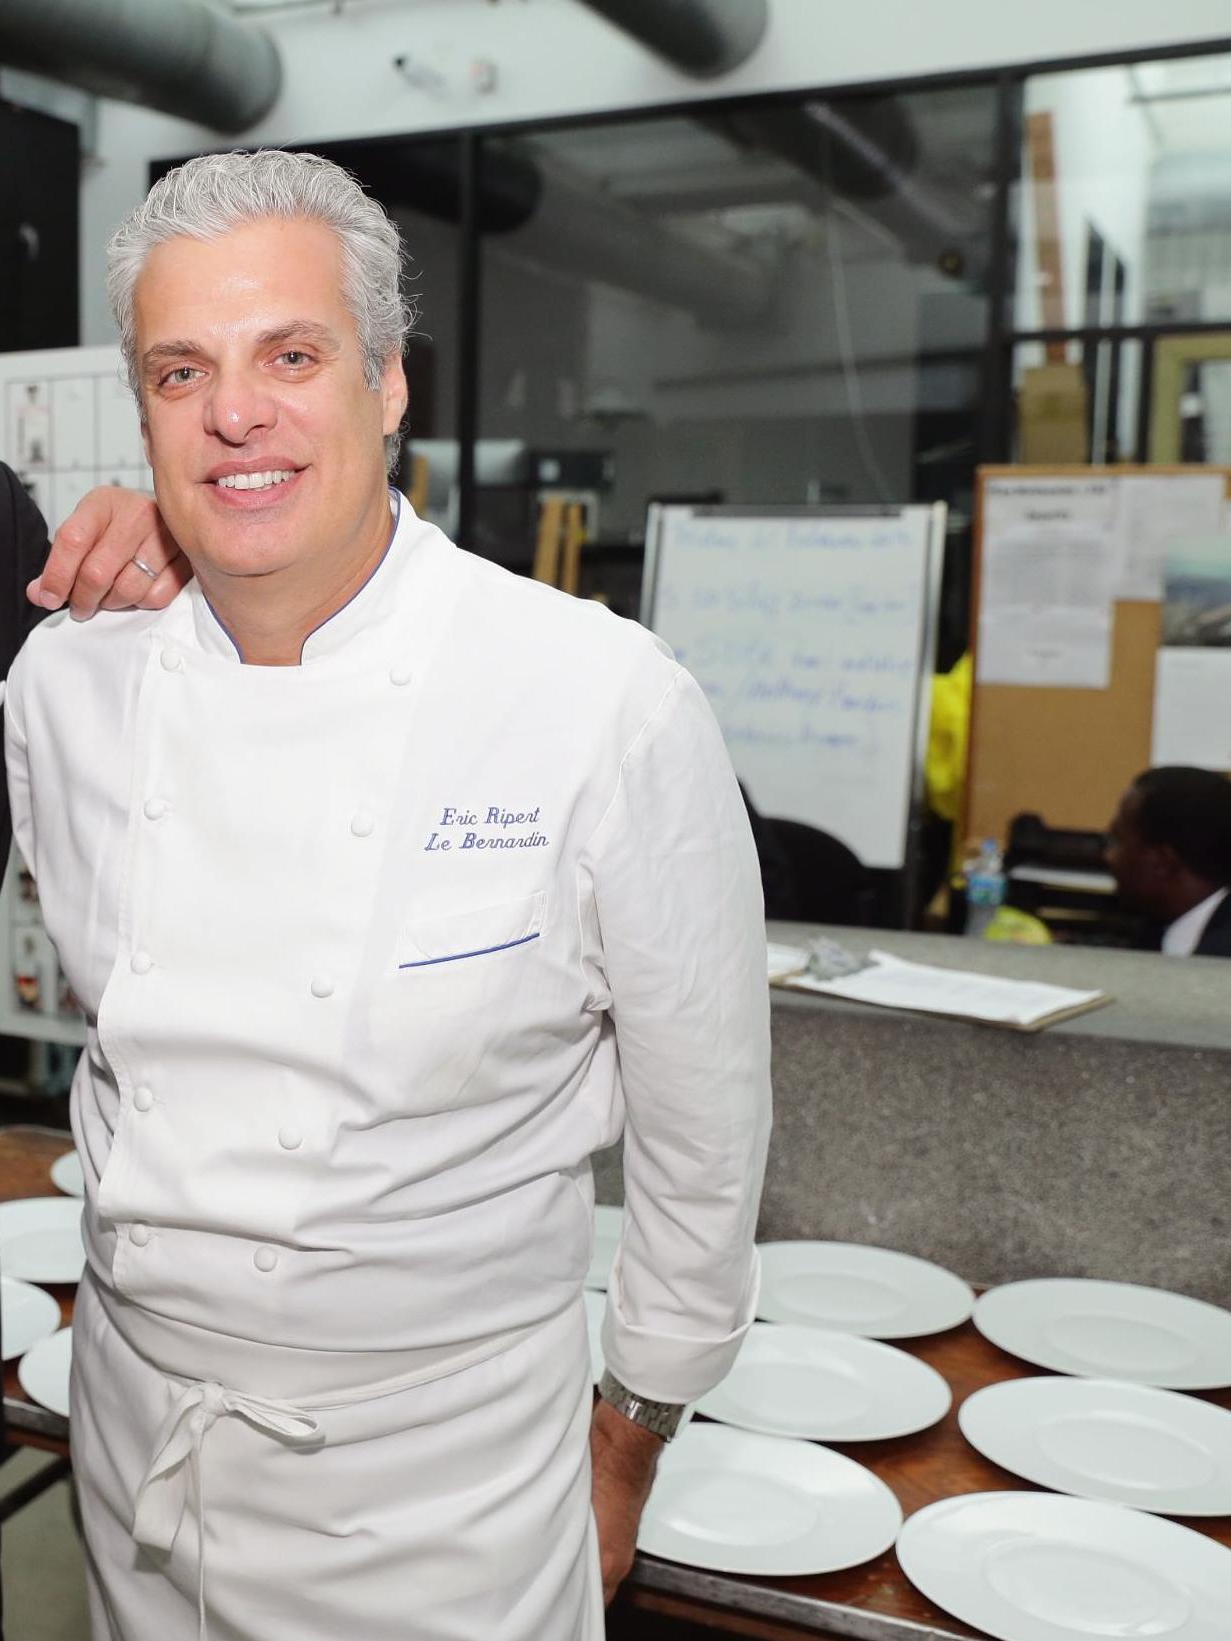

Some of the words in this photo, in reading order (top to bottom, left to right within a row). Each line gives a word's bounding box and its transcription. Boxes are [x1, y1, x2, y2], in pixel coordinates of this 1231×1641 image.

[439, 807, 479, 826] Eric
[484, 806, 541, 829] Ripert
[424, 833, 452, 851] Le
[458, 831, 550, 849] Bernardin
